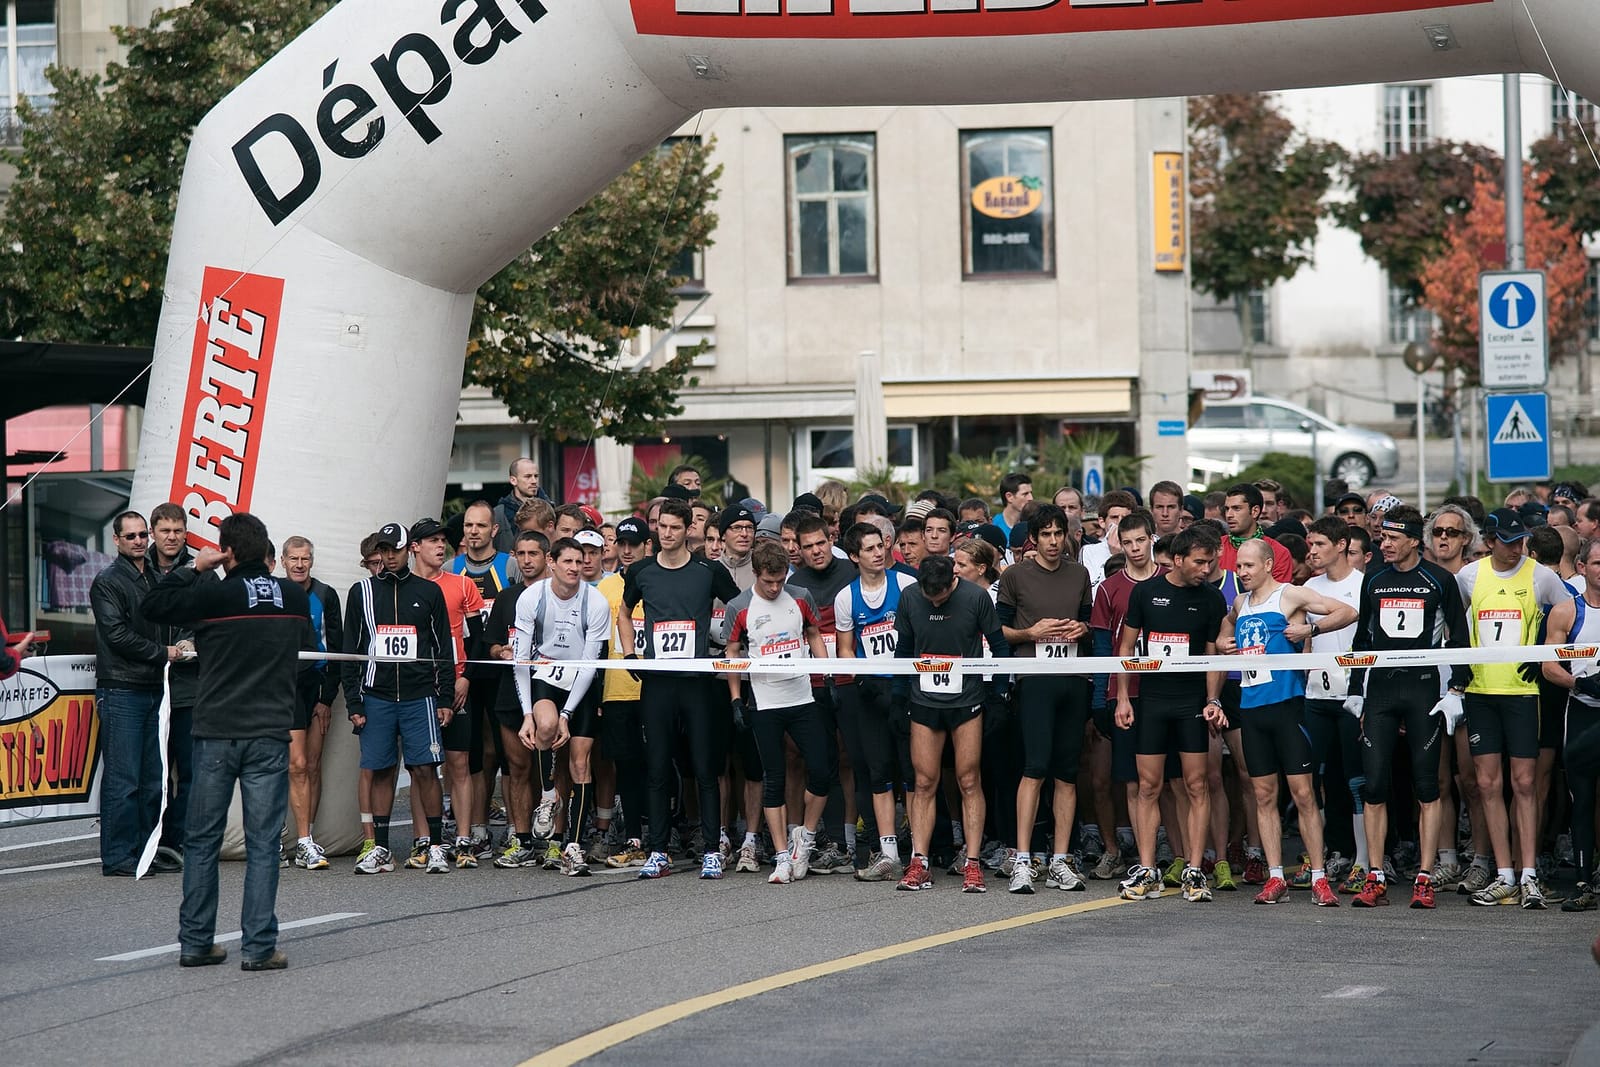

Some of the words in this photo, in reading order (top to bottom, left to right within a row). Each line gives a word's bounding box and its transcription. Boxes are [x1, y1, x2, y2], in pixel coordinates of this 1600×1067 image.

[1397, 610, 1406, 631] 2
[1481, 611, 1489, 619] LA
[870, 623, 894, 634] LIBERT
[1494, 621, 1503, 641] 7
[384, 636, 409, 656] 169
[661, 632, 687, 653] 227
[764, 647, 774, 655] LA
[774, 641, 799, 654] LIBERTÉ
[870, 632, 896, 656] 270
[1321, 671, 1330, 691] 8
